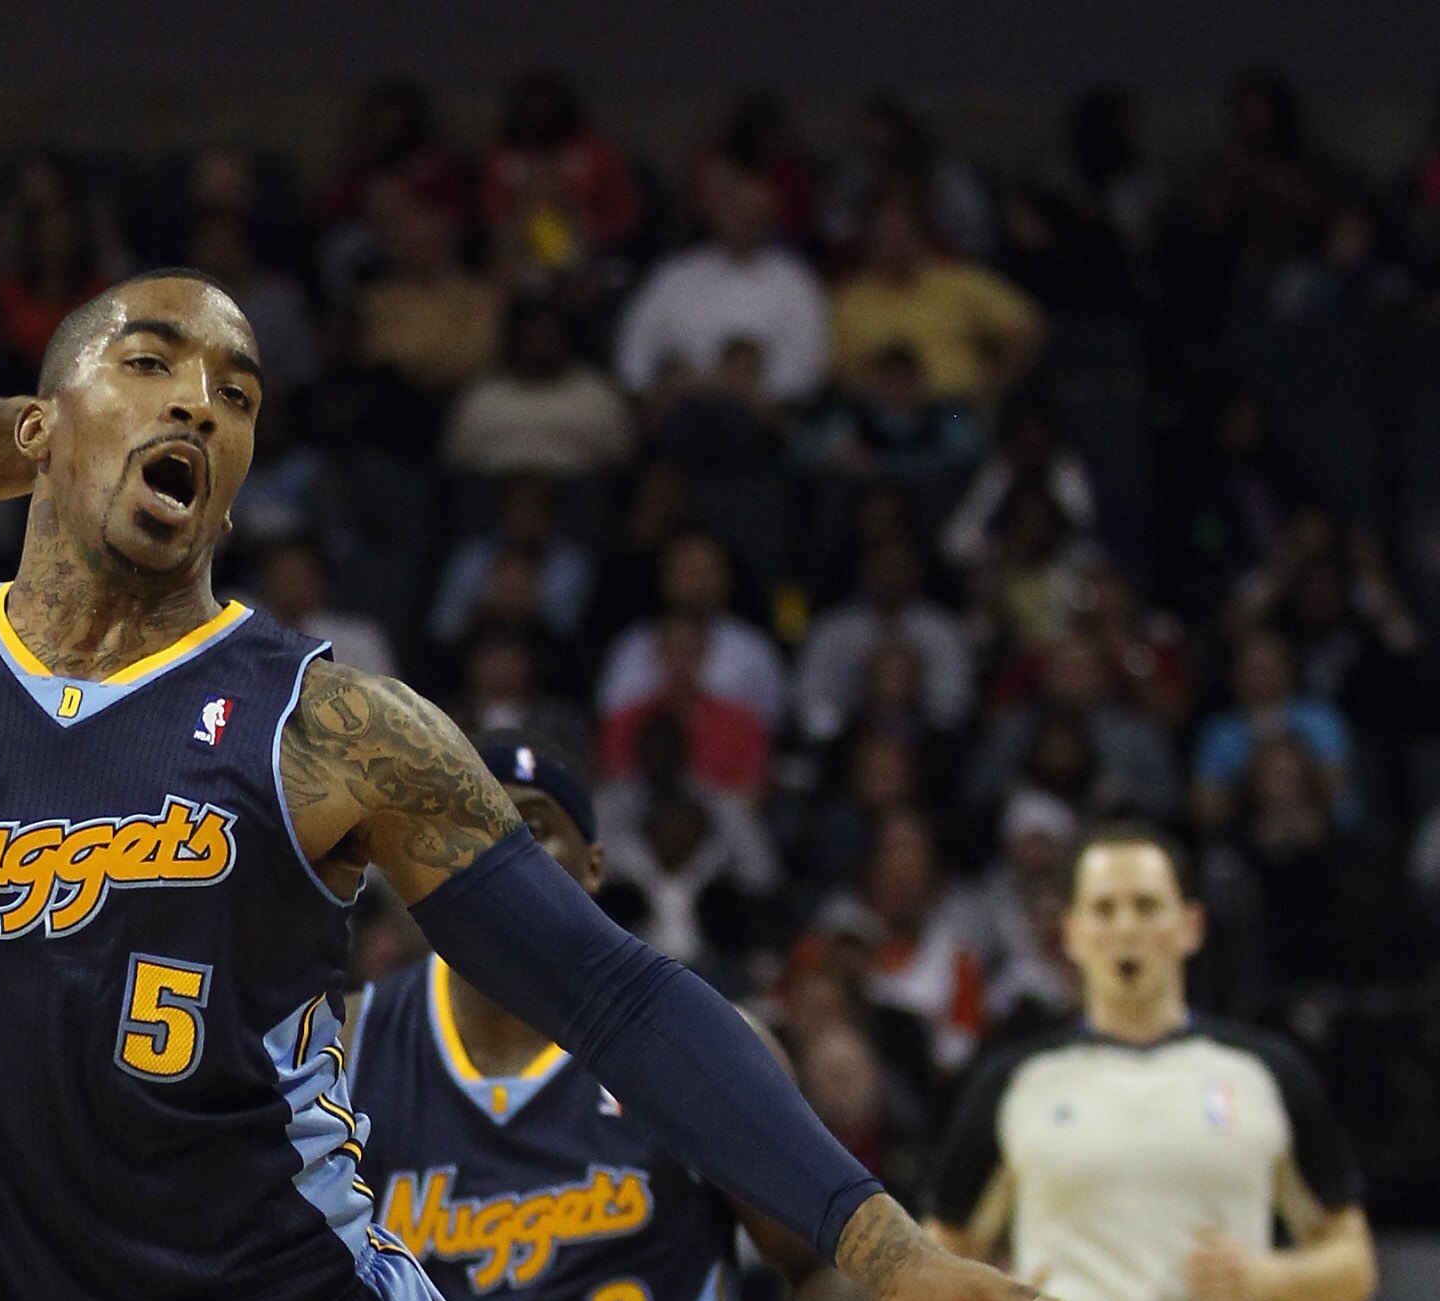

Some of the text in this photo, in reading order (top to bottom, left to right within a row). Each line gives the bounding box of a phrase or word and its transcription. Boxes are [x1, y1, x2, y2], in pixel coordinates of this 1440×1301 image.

[56, 684, 84, 719] D
[113, 952, 214, 1084] 5
[381, 1163, 653, 1295] Nuggets
